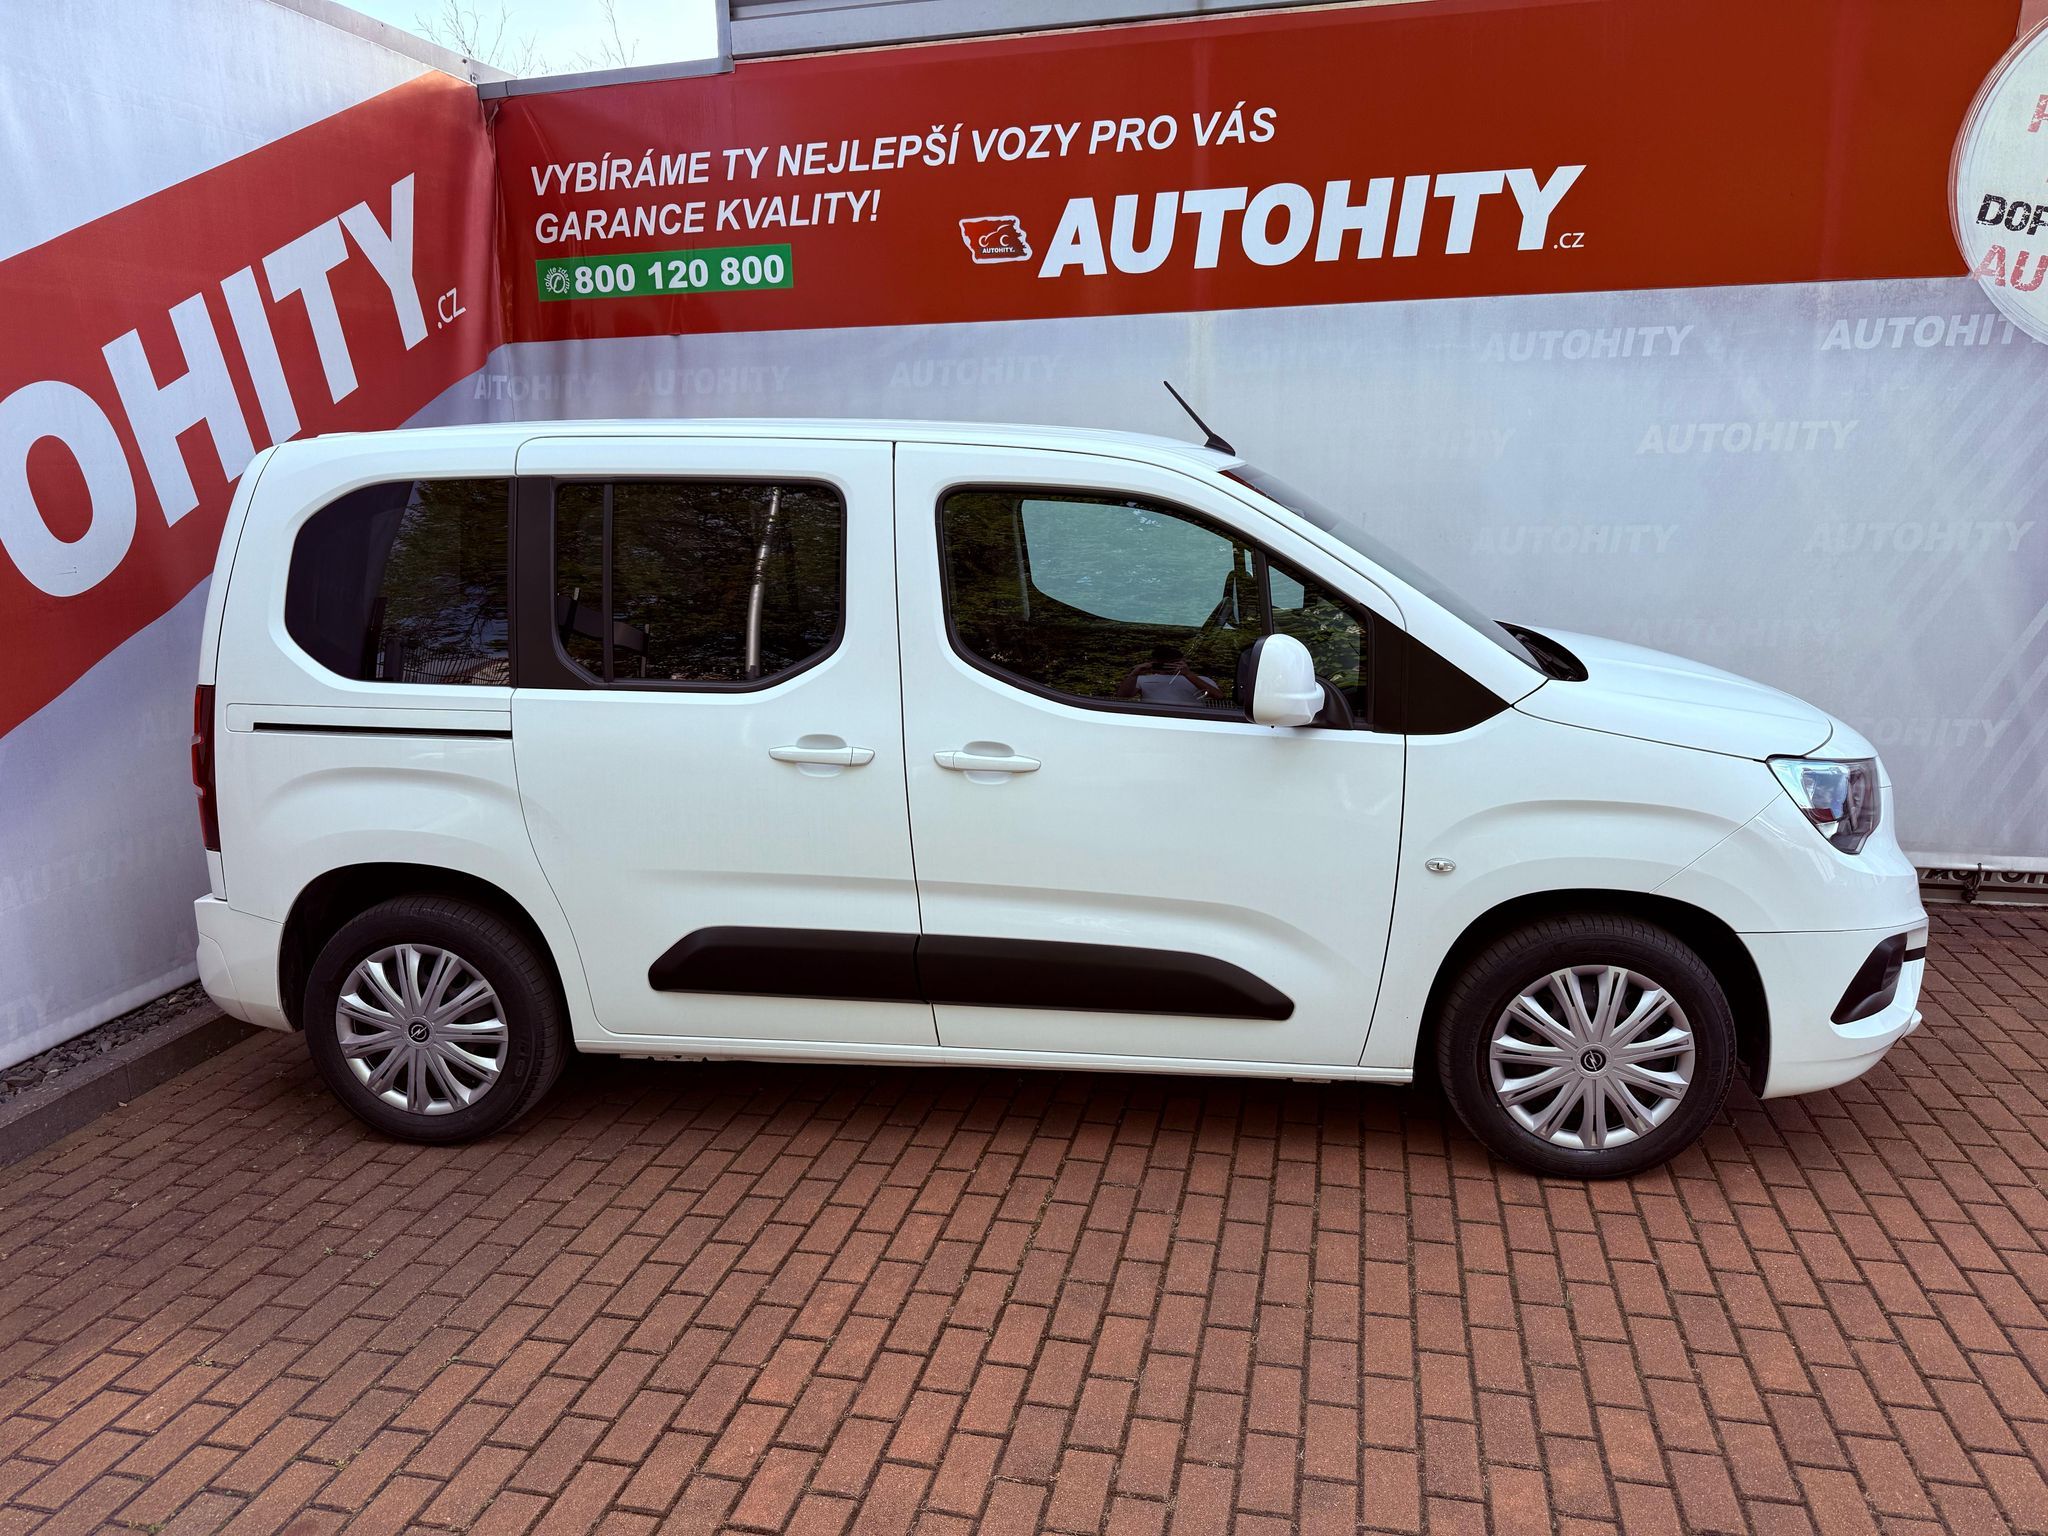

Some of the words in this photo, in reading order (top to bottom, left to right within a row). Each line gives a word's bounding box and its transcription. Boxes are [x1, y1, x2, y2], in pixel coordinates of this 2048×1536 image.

[531, 148, 711, 196] VYBÍRÁME
[722, 146, 769, 181] TY
[776, 123, 964, 177] NEJLEPŠÍ
[971, 122, 1082, 163] VOZY
[1088, 115, 1178, 155] PRO
[1192, 101, 1278, 147] VÁS
[535, 202, 706, 244] GARANCE
[716, 189, 881, 232] KVALITY!
[574, 264, 636, 294] 800
[647, 258, 709, 289] 120
[720, 254, 785, 286] 800
[1478, 325, 1695, 363] AUTOHITY
[1820, 313, 2048, 352] AUTOHIT
[1635, 419, 1860, 455] AUTOHITY
[1470, 524, 1680, 556] AUTOHITY
[1803, 521, 2035, 554] AUTOHITY
